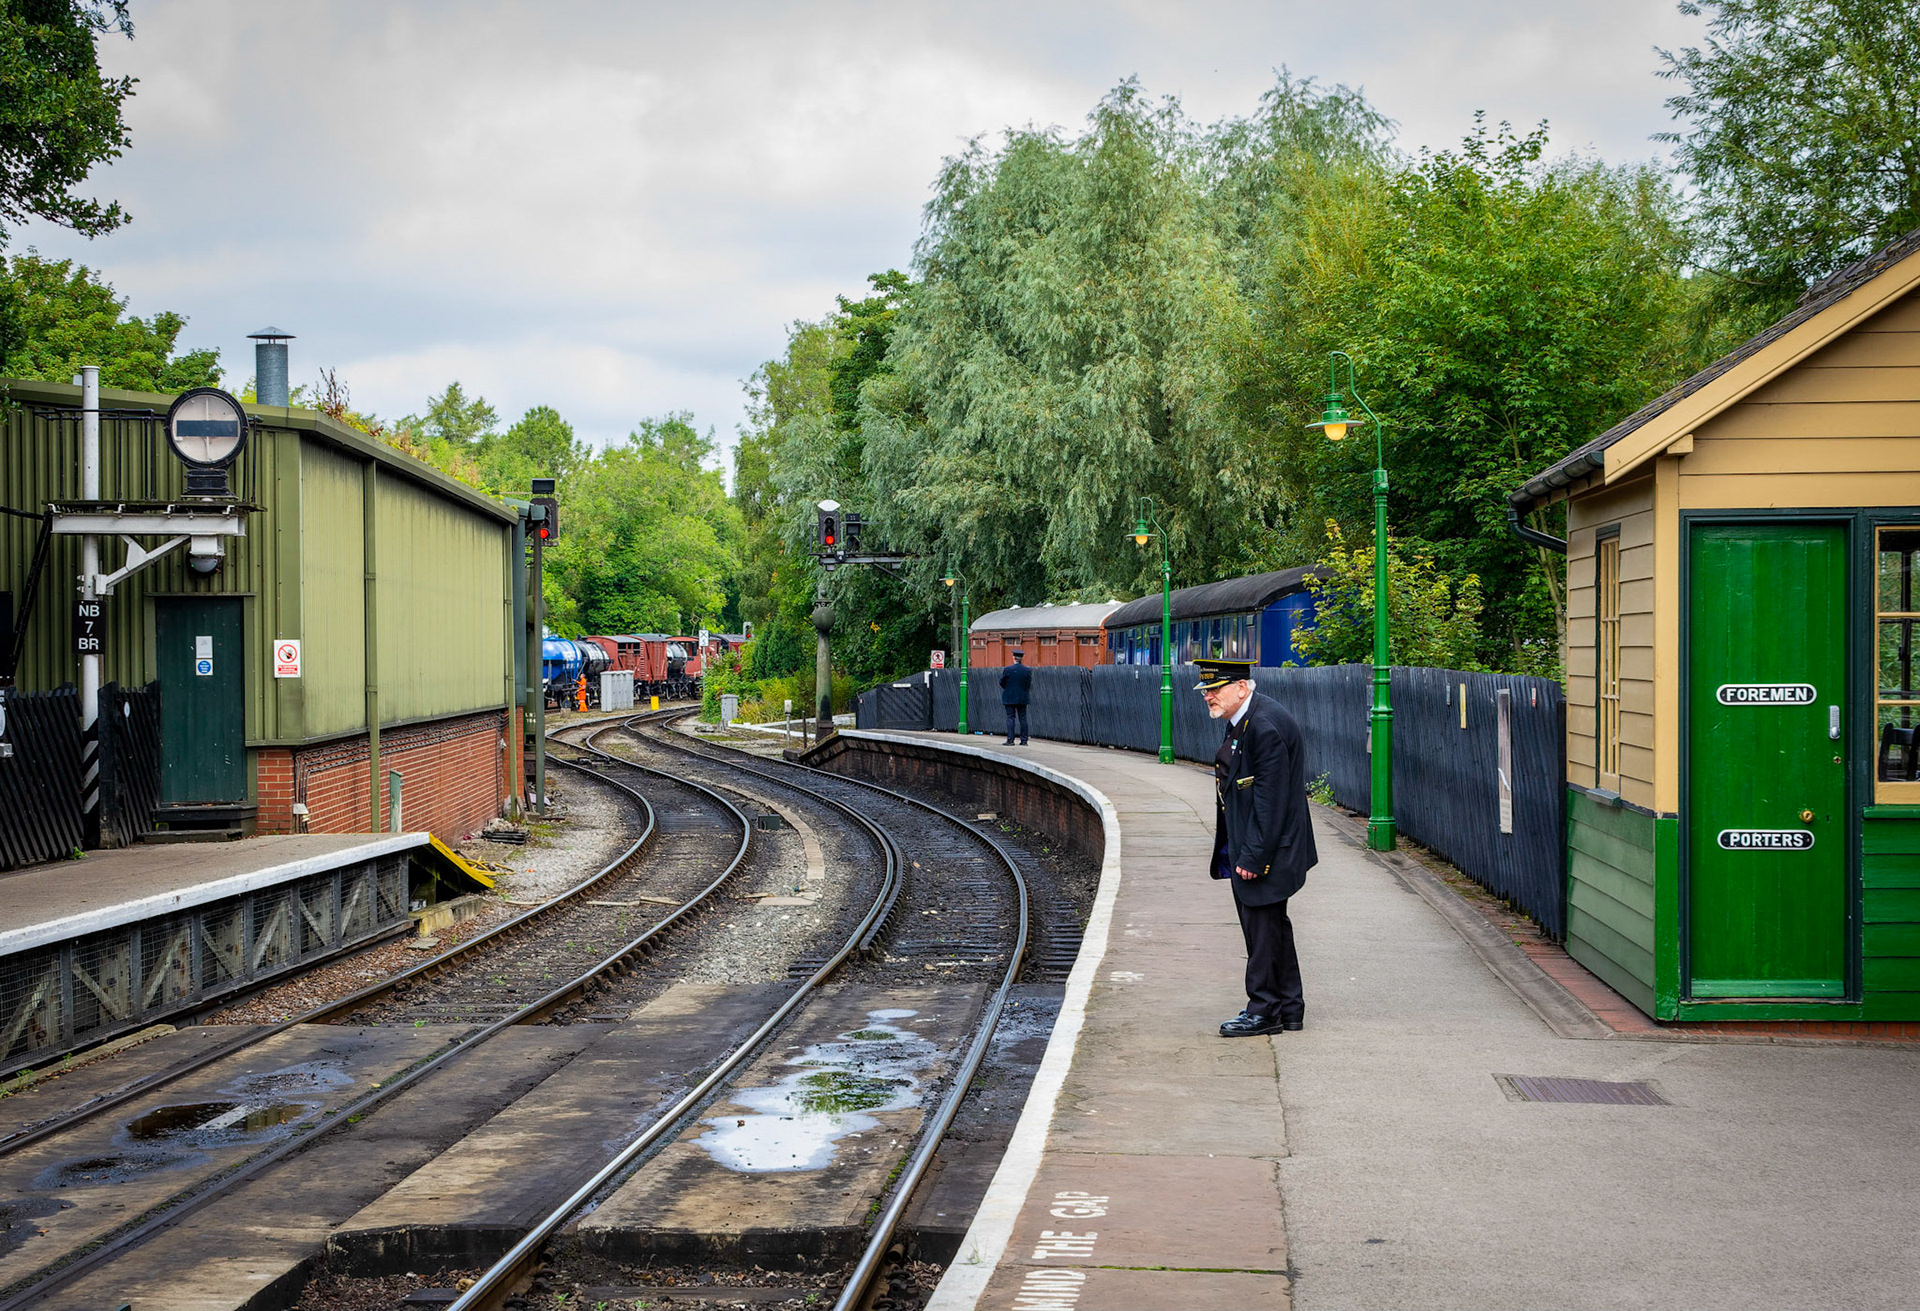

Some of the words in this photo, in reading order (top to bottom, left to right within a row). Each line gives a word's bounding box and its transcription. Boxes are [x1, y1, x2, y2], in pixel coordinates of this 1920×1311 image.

[78, 604, 100, 617] NB
[84, 621, 94, 634] 7
[78, 637, 99, 650] BR
[1726, 687, 1808, 701] FOREMEN
[1729, 832, 1804, 847] PORTERS
[1049, 1190, 1110, 1218] GAP
[1031, 1230, 1098, 1260] THE
[1011, 1269, 1086, 1311] MIND
